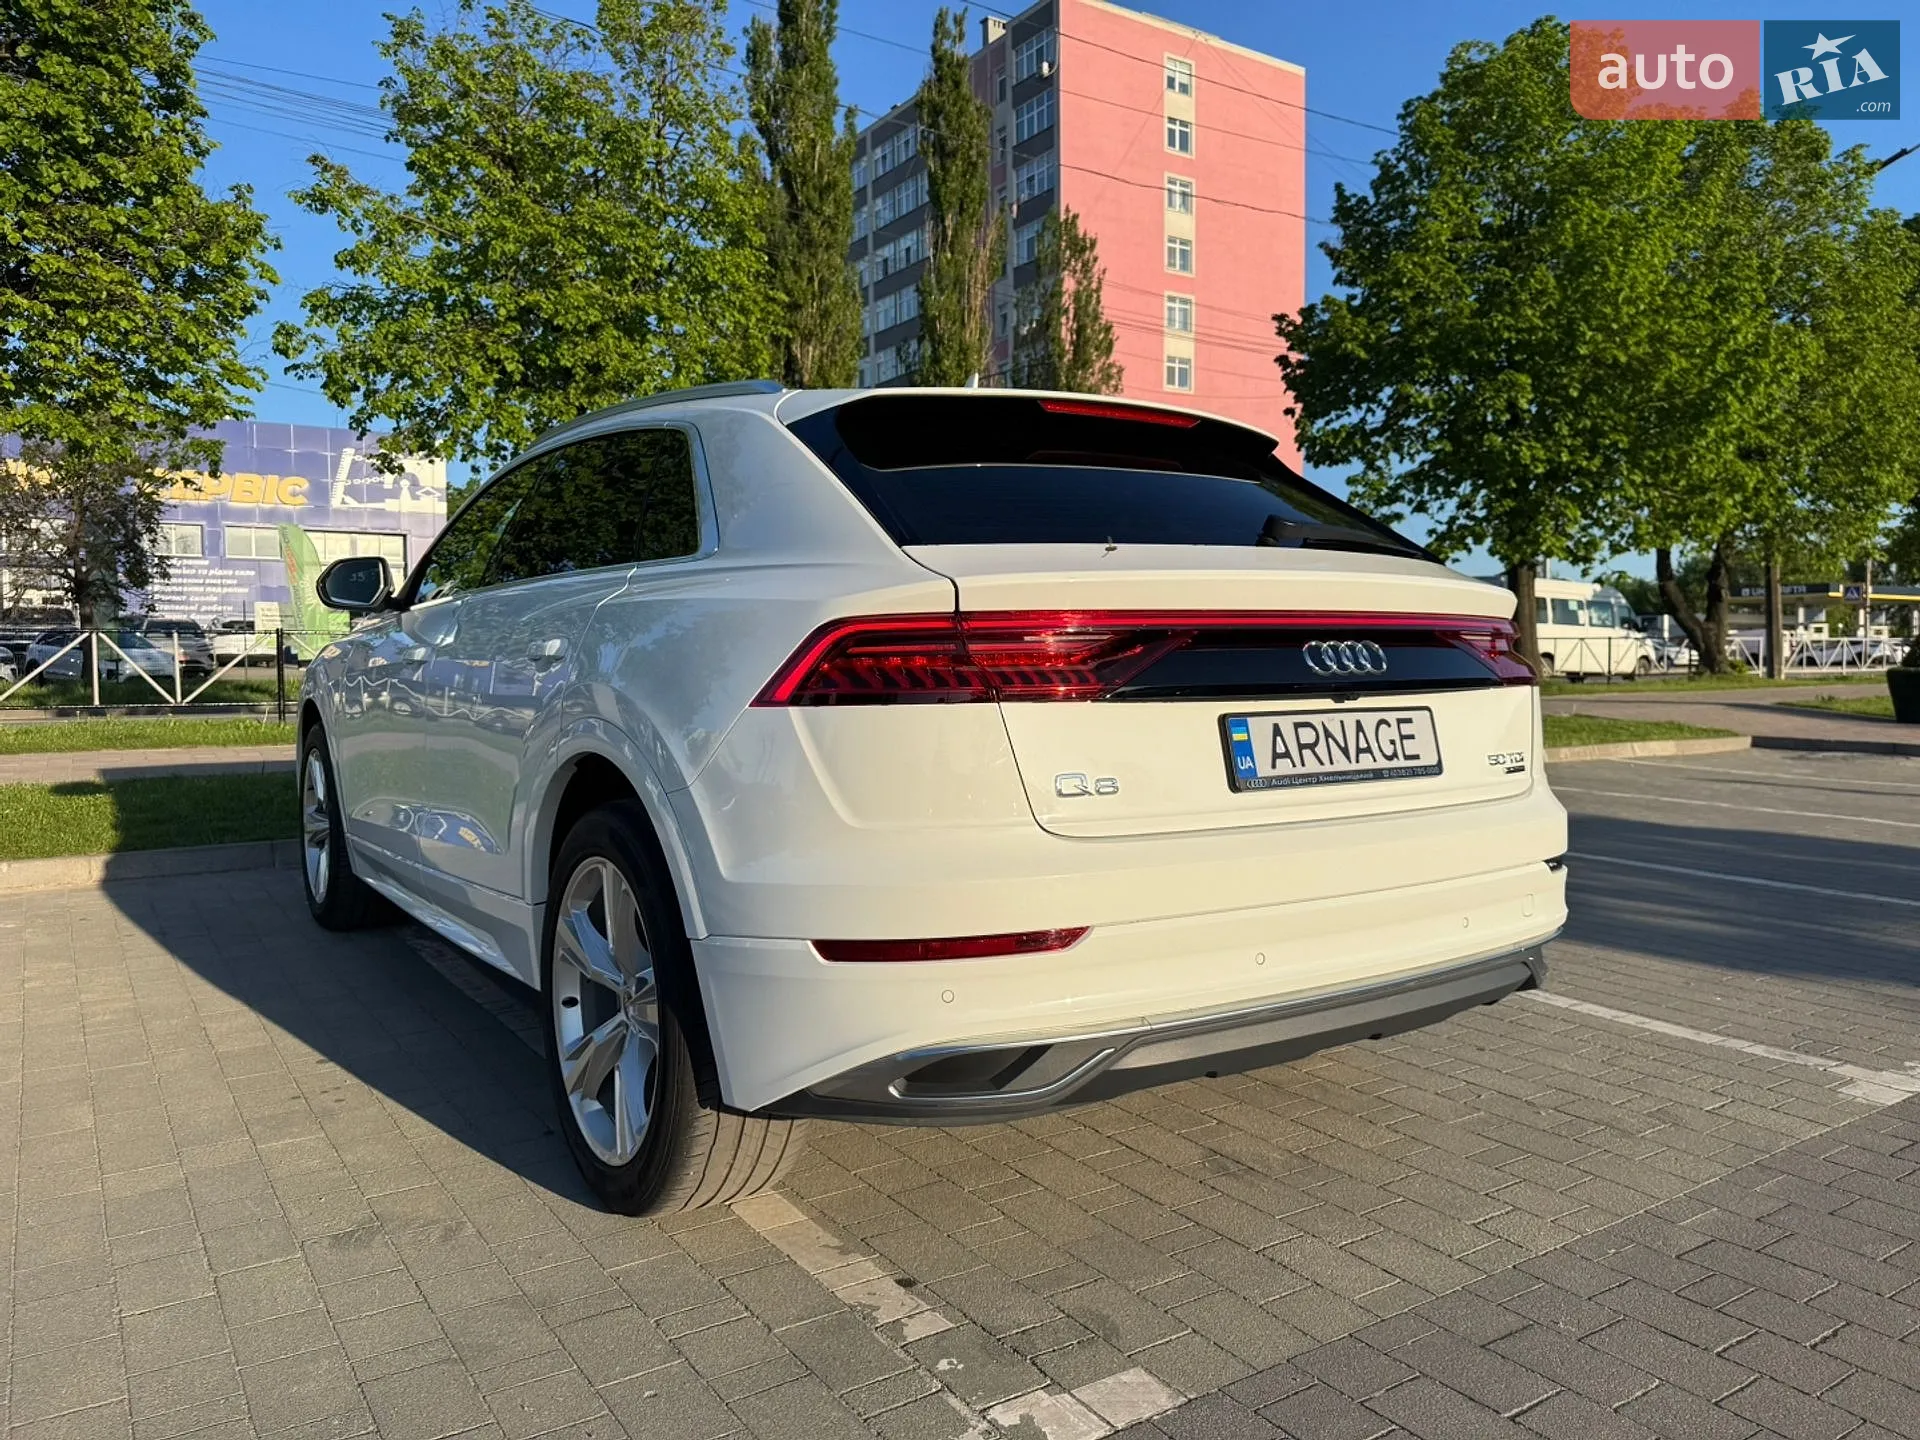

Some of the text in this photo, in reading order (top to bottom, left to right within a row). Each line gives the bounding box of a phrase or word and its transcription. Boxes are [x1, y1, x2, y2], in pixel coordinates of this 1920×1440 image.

[1271, 717, 1420, 770] ARNAGE
[1237, 755, 1254, 770] UA
[1271, 777, 1291, 787] Audi
[1292, 775, 1318, 785] Центр
